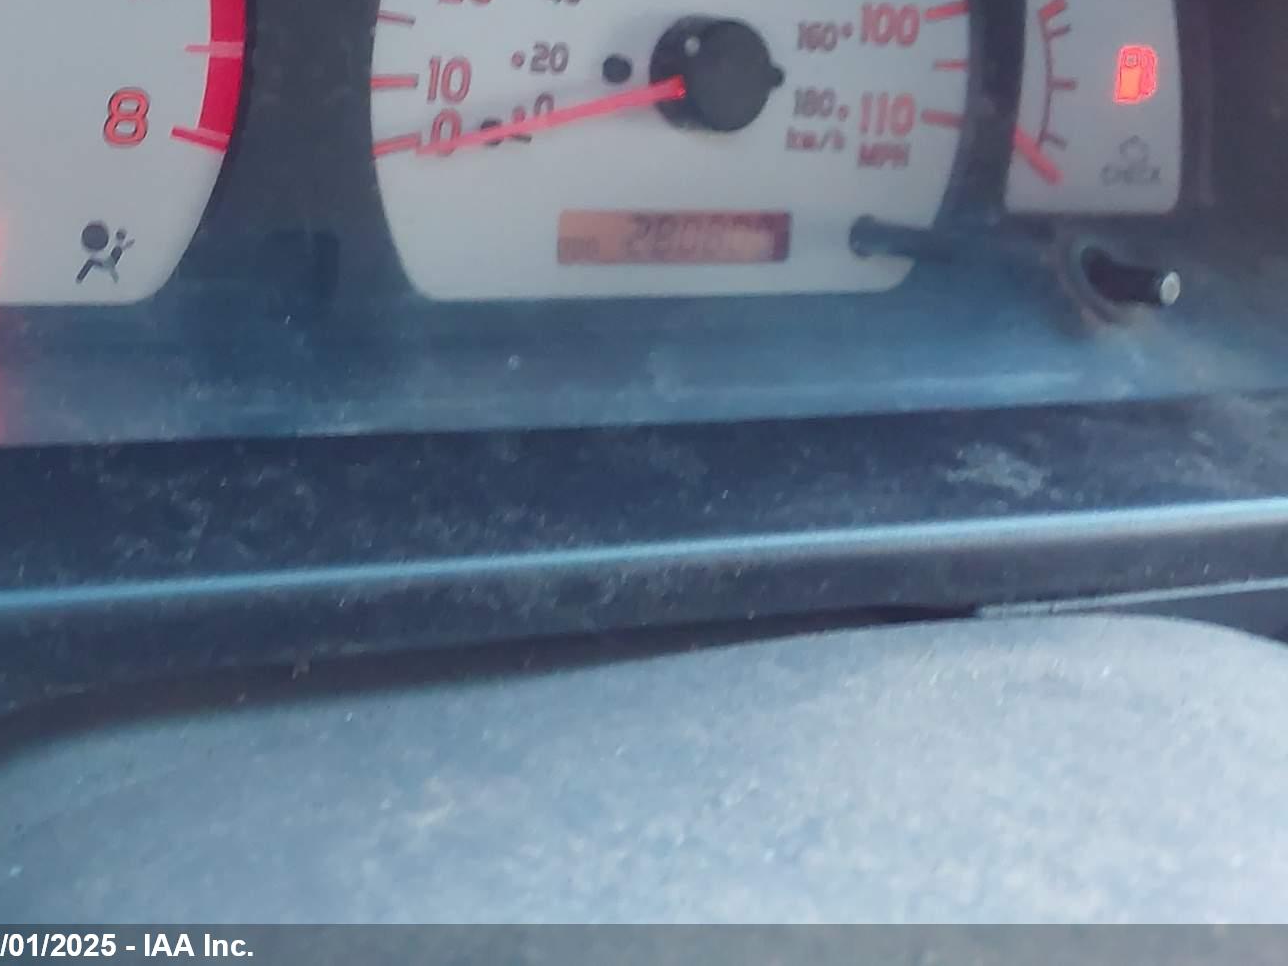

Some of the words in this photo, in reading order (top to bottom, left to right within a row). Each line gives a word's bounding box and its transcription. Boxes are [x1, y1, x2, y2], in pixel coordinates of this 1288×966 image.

[858, 2, 920, 48] 100
[426, 55, 472, 105] 10
[530, 41, 569, 74] 20
[103, 86, 150, 147] 8
[428, 107, 462, 157] 0
[857, 91, 916, 138] 110
